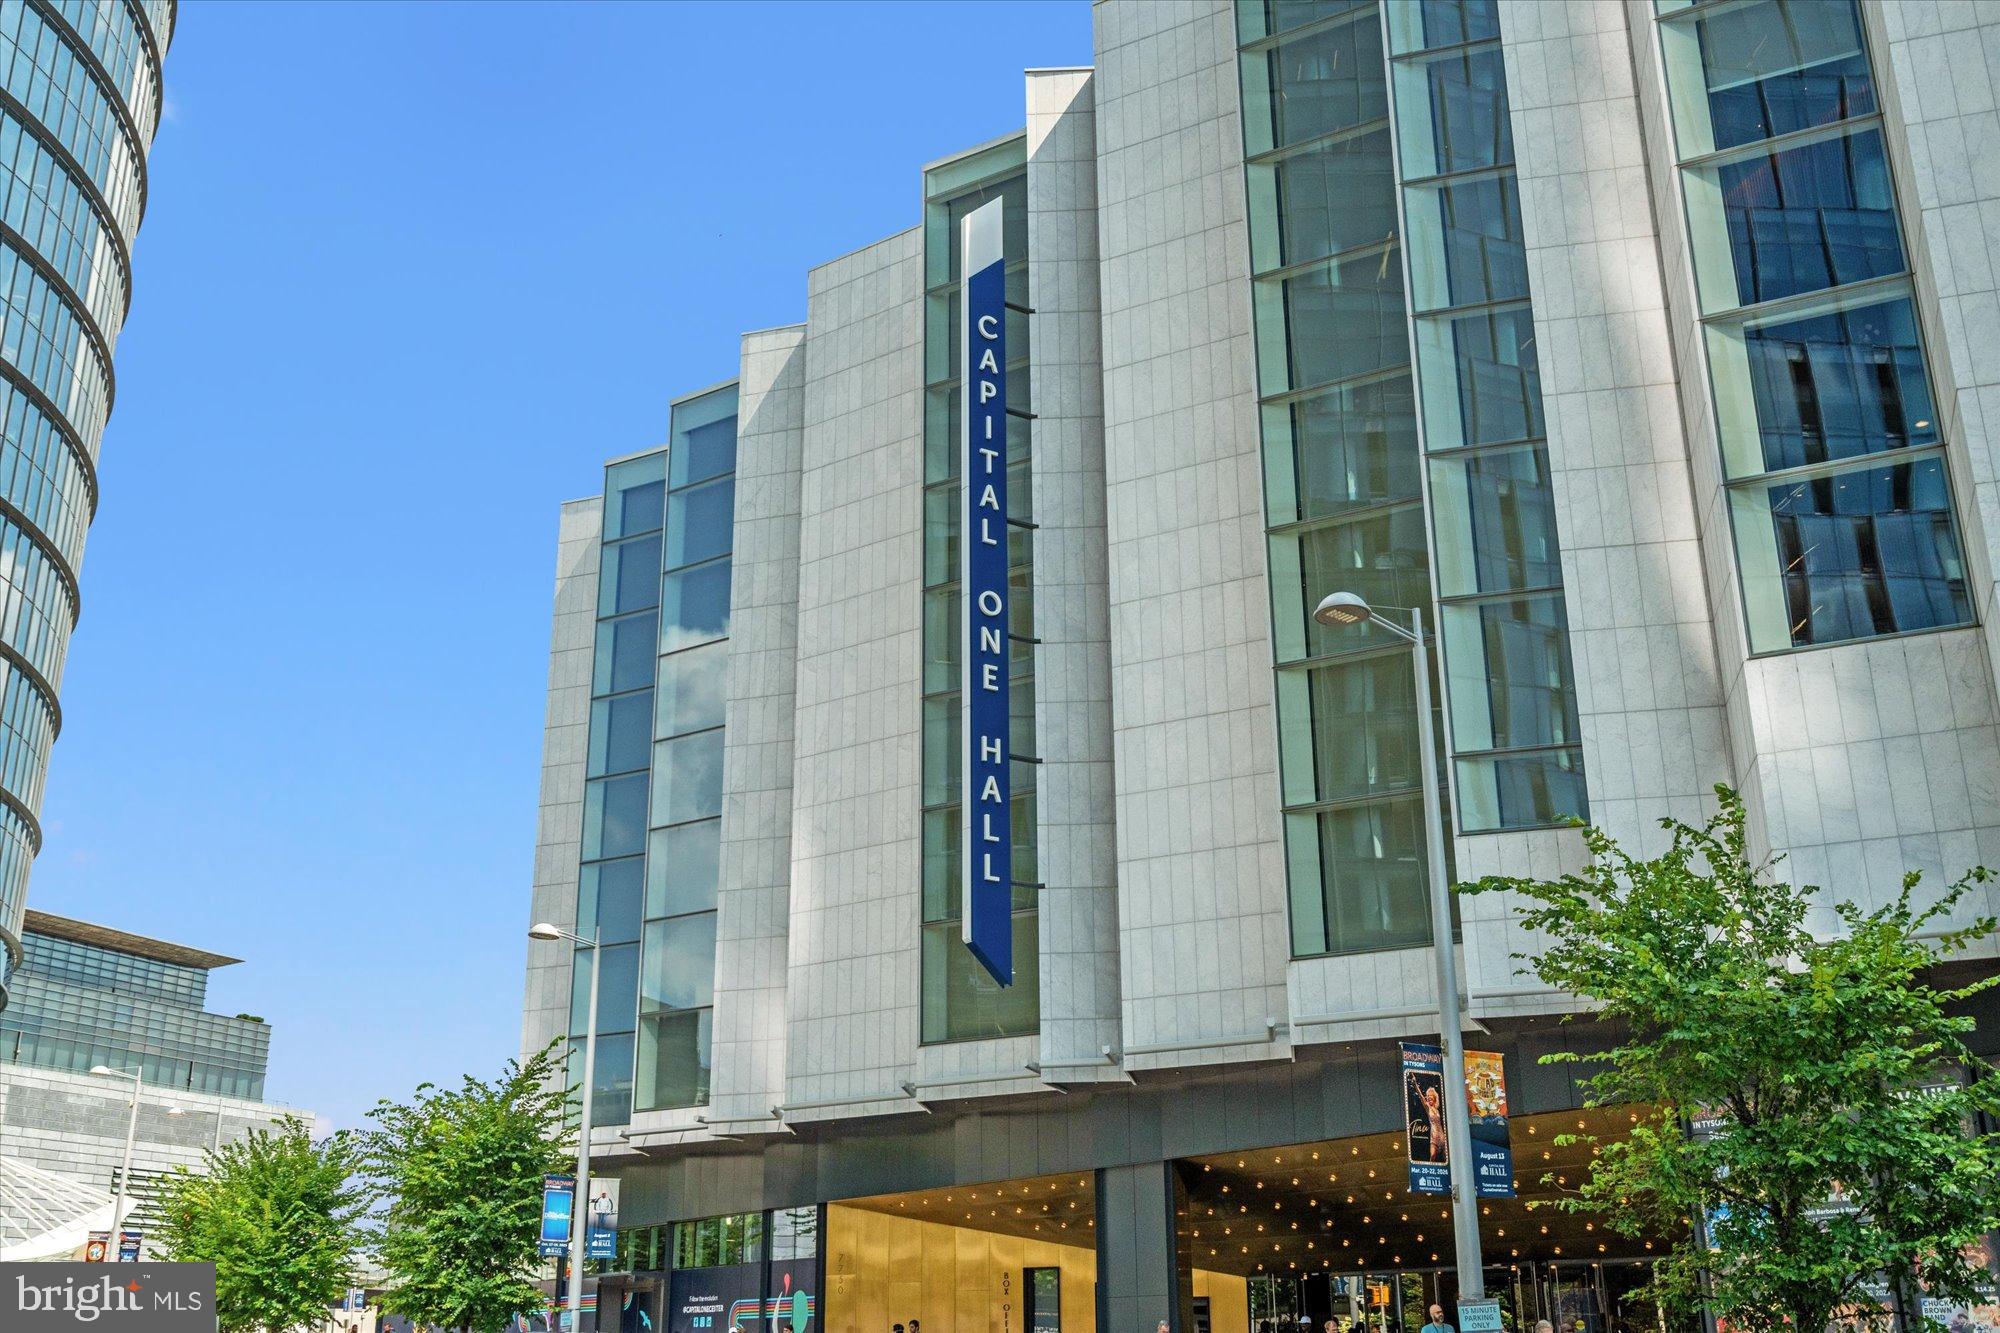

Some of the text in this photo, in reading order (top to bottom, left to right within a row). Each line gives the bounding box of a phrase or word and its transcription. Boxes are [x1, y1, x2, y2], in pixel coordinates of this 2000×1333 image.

[978, 315, 1002, 882] CAPITAL ONE HALL
[1403, 1051, 1441, 1064] BROADWAY
[1480, 1152, 1497, 1160] August
[1489, 1168, 1507, 1176] HALL
[1002, 1271, 1010, 1296] BOX
[1470, 1306, 1498, 1314] MINUTE
[1464, 1314, 1494, 1322] PARKING
